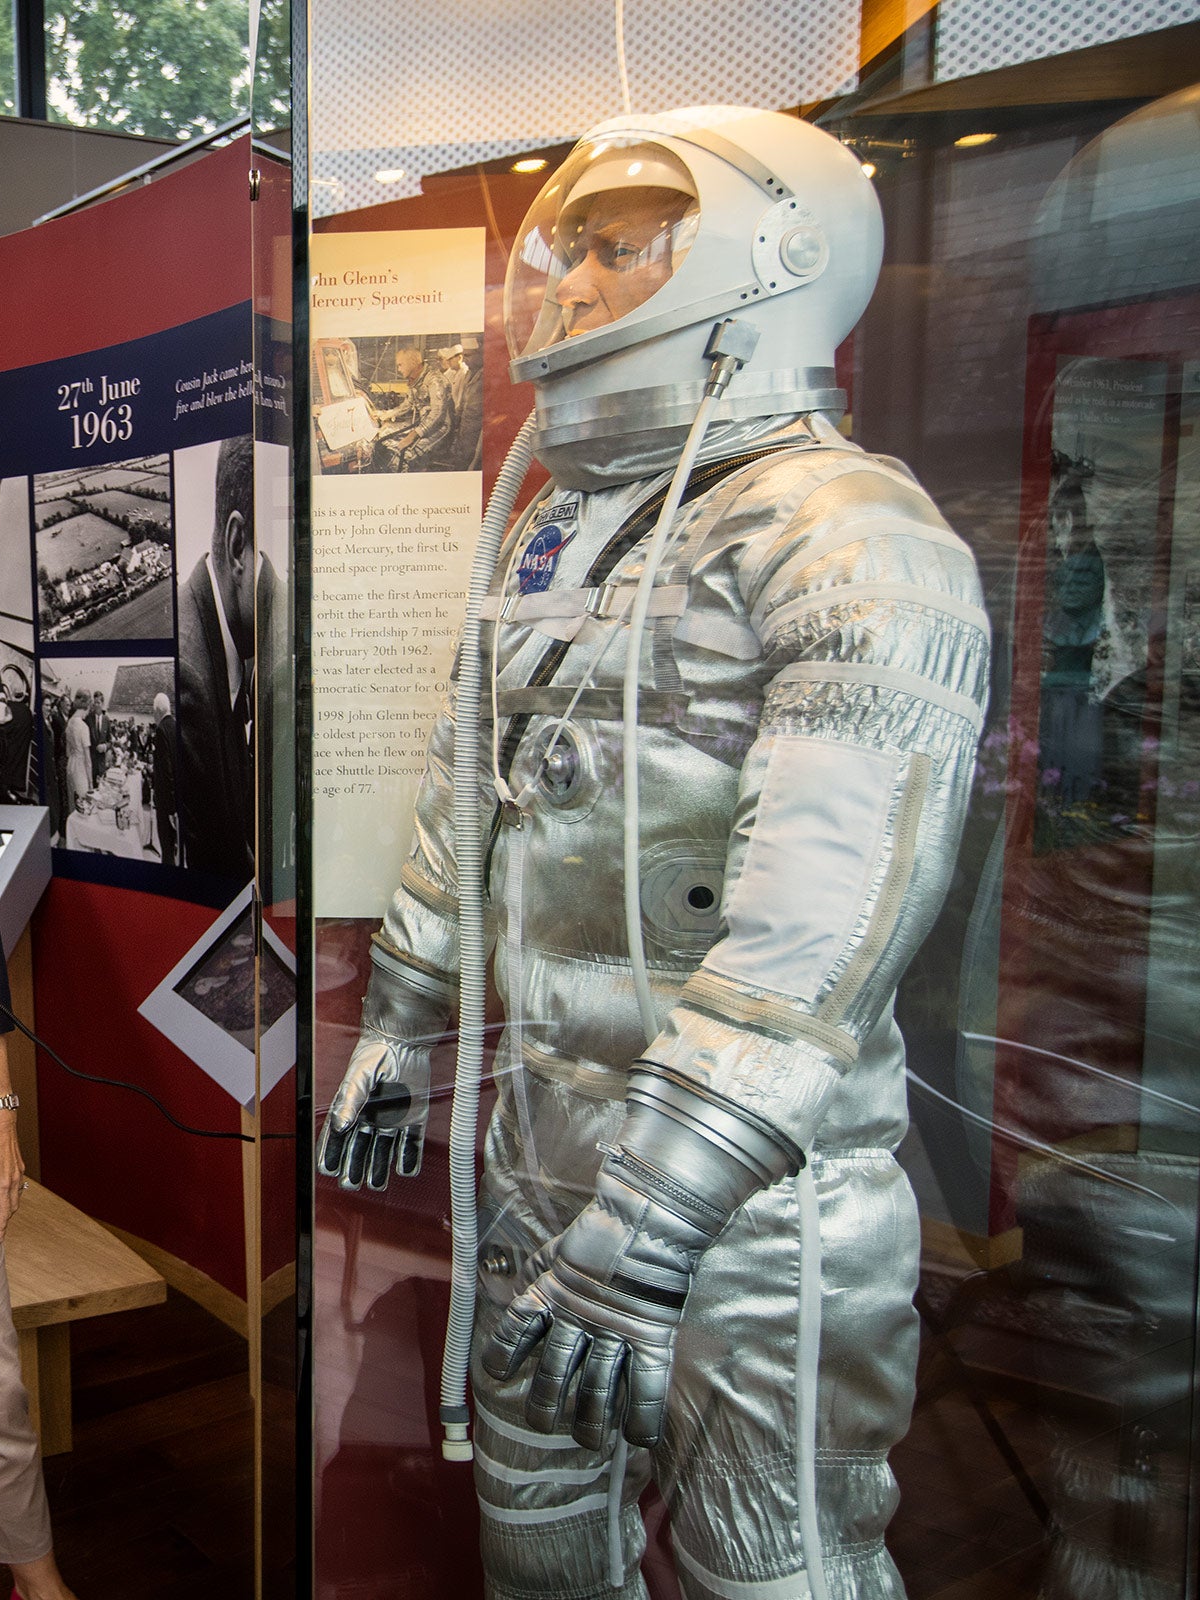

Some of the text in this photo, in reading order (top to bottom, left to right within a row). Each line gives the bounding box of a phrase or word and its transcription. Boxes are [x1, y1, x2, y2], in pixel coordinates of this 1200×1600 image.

[343, 269, 398, 285] Glenn's
[371, 290, 443, 309] Spacesuit
[175, 360, 253, 393] Cousin Jack came her
[58, 375, 141, 411] 27th June
[173, 400, 189, 421] fire
[190, 393, 205, 411] and
[206, 391, 224, 407] blew
[225, 386, 237, 402] the
[238, 380, 253, 398] bell
[70, 404, 133, 449] 1963
[329, 507, 337, 517] is
[340, 509, 346, 517] a
[349, 505, 385, 520] replica
[388, 504, 400, 516] of
[402, 504, 419, 515] the
[422, 504, 470, 519] spacesuit
[312, 522, 451, 539] orn by John Glenn during
[345, 544, 394, 557] Mercury,
[397, 542, 414, 553] the
[417, 542, 438, 552] first
[442, 542, 459, 552] US
[312, 562, 448, 577] anned space programme.
[522, 553, 553, 573] NASA
[322, 590, 363, 601] became
[367, 589, 385, 600] the
[388, 589, 409, 600] first
[413, 589, 466, 600] American
[317, 606, 448, 620] orbit the Earth when he
[329, 627, 347, 638] the
[350, 626, 408, 640] Friendship
[411, 626, 419, 637] 7
[320, 646, 368, 660] February
[372, 645, 397, 656] 20th
[402, 644, 432, 656] 1962.
[322, 667, 342, 675] was
[346, 664, 370, 675] later
[374, 663, 413, 675] elected
[416, 666, 427, 674] as
[430, 666, 436, 674] a
[312, 683, 367, 694] emocratic
[370, 682, 412, 694] Senator
[414, 681, 431, 693] for
[318, 709, 437, 724] 1998 John Glenn beca
[323, 728, 355, 739] oldest
[359, 731, 396, 743] person
[400, 731, 411, 739] to
[414, 728, 427, 742] fly
[313, 750, 332, 758] ace
[335, 747, 364, 757] when
[368, 746, 380, 757] he
[383, 746, 407, 757] flew
[314, 764, 425, 776] ace Shuttle Discover
[322, 787, 341, 798] age
[344, 783, 356, 794] of
[358, 783, 375, 794] 77.
